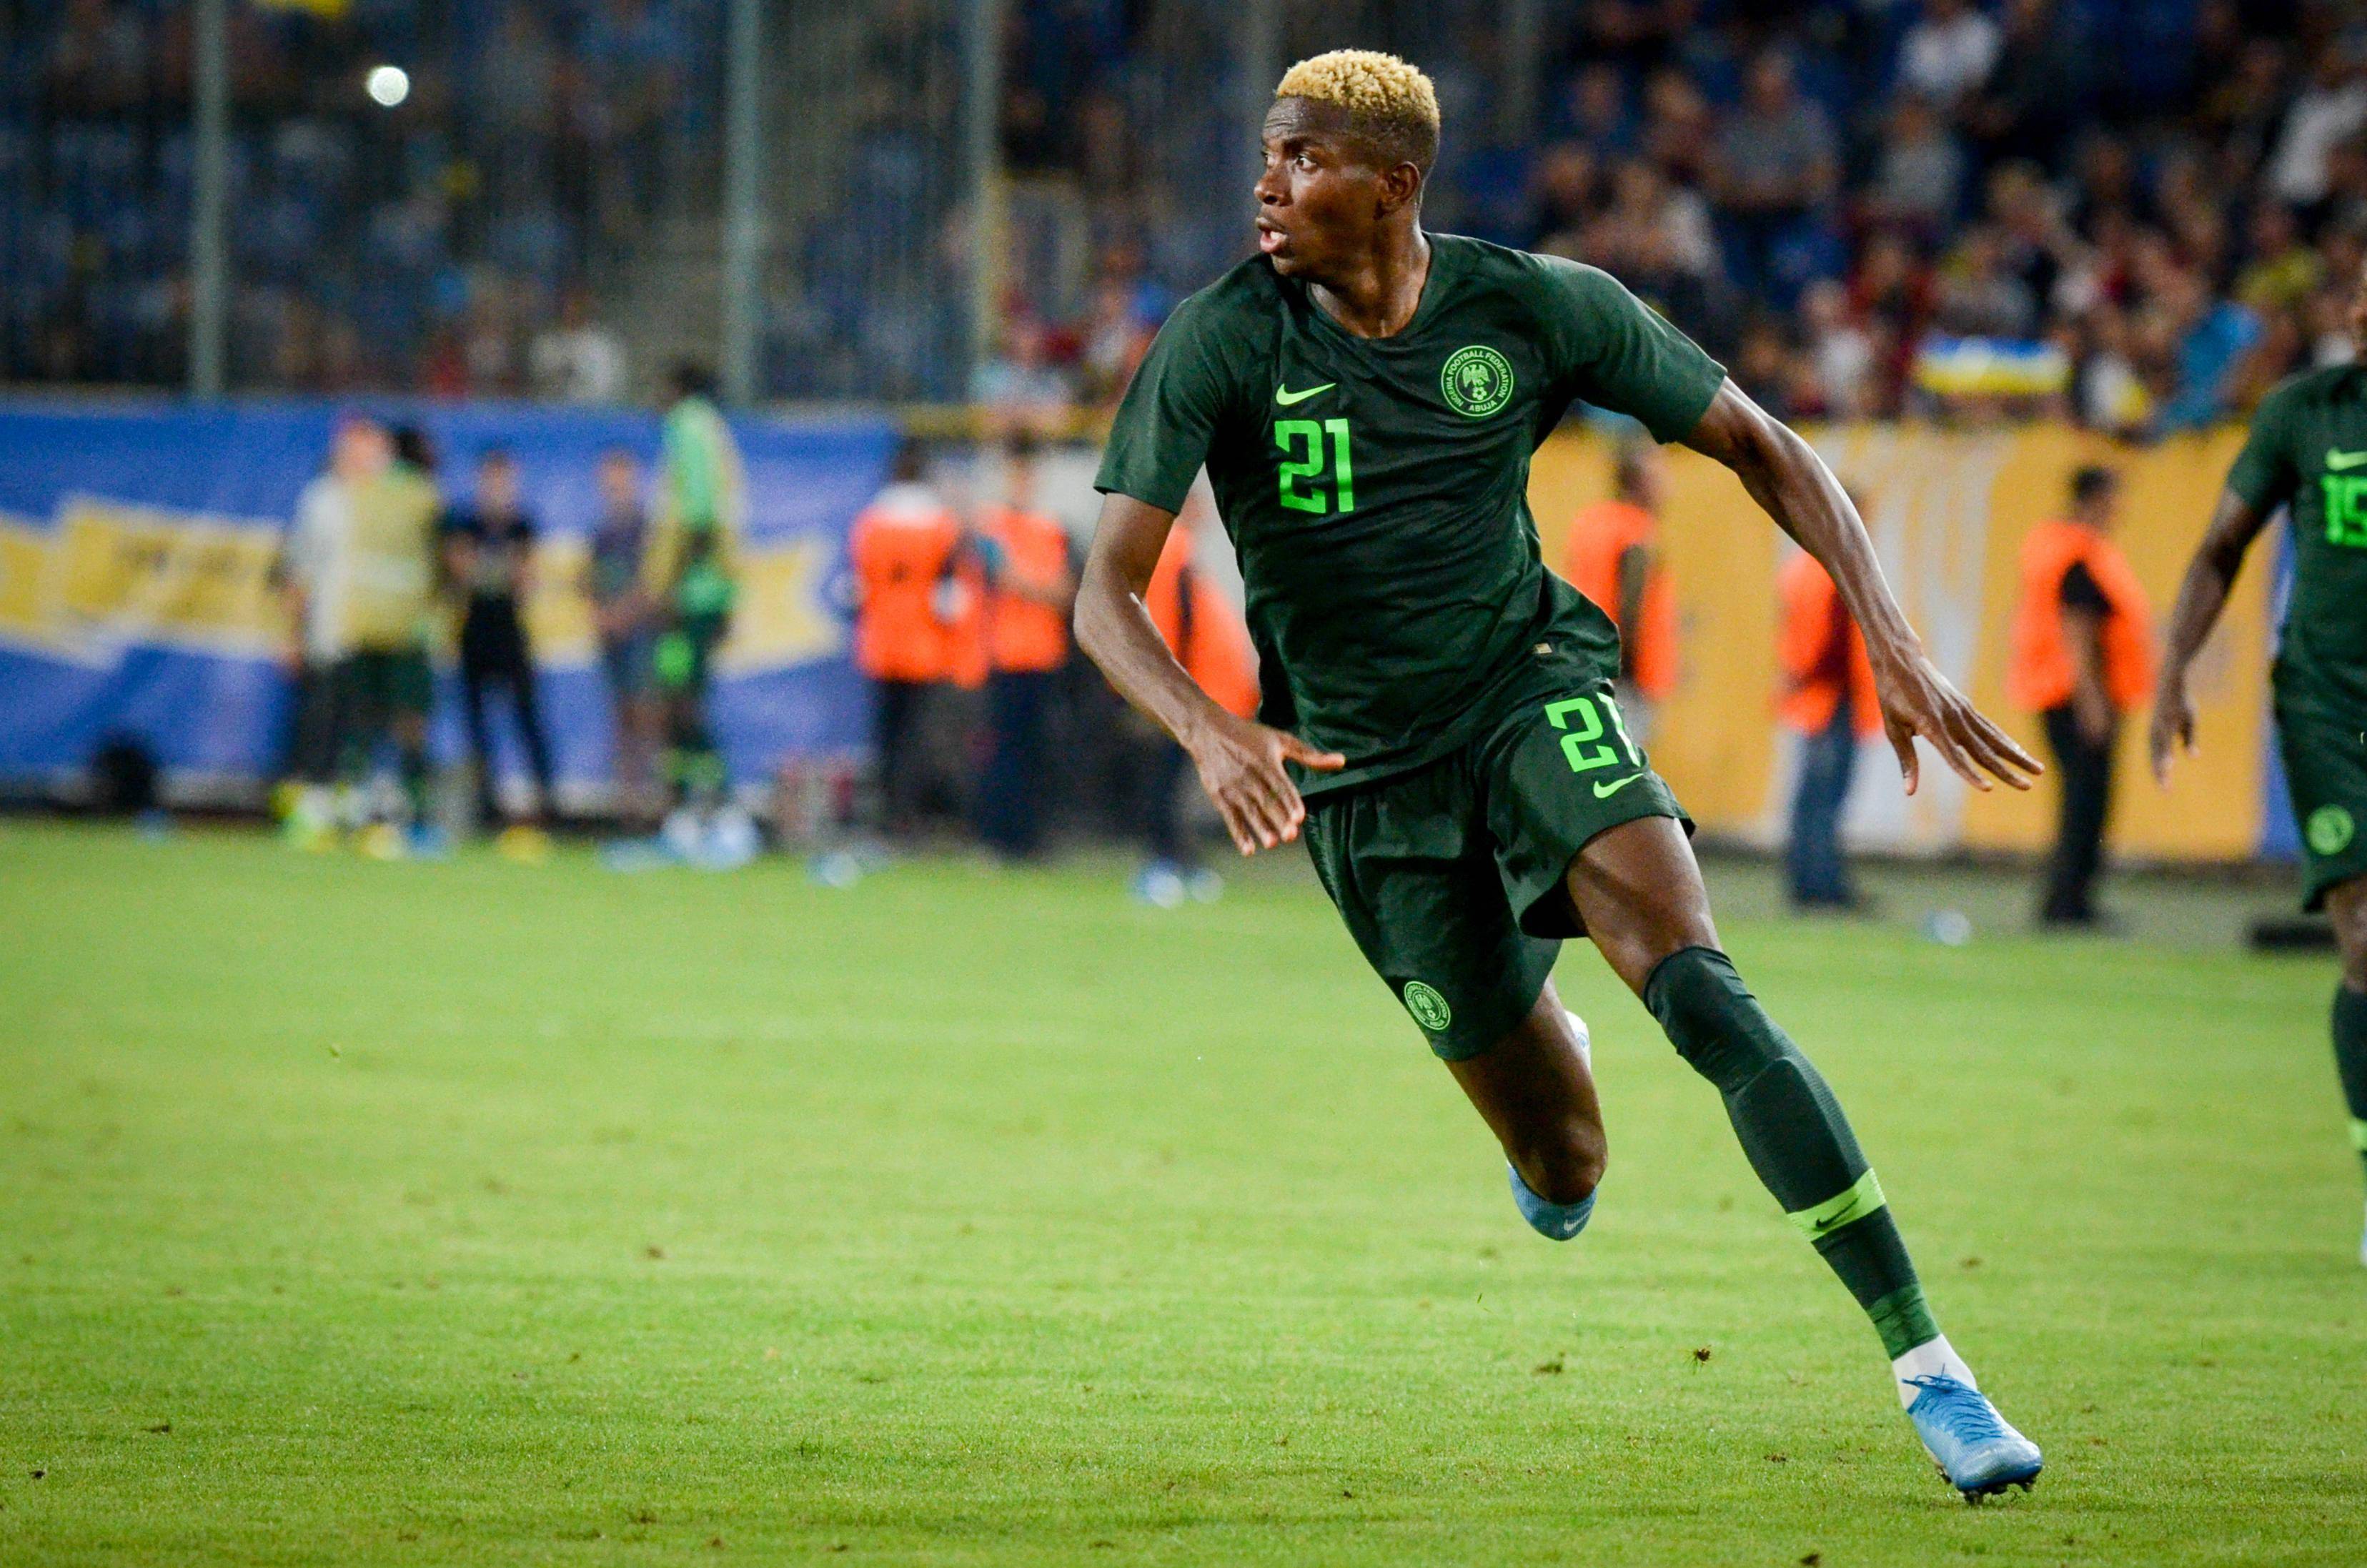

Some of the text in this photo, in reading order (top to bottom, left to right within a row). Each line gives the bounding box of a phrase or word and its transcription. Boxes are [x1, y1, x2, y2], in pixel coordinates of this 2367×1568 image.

[1446, 350, 1509, 407] NIGERIA FOOTBALL FEDERATION
[1469, 400, 1497, 412] ABUJA
[1274, 418, 1354, 514] 21
[1544, 692, 1641, 773] 21
